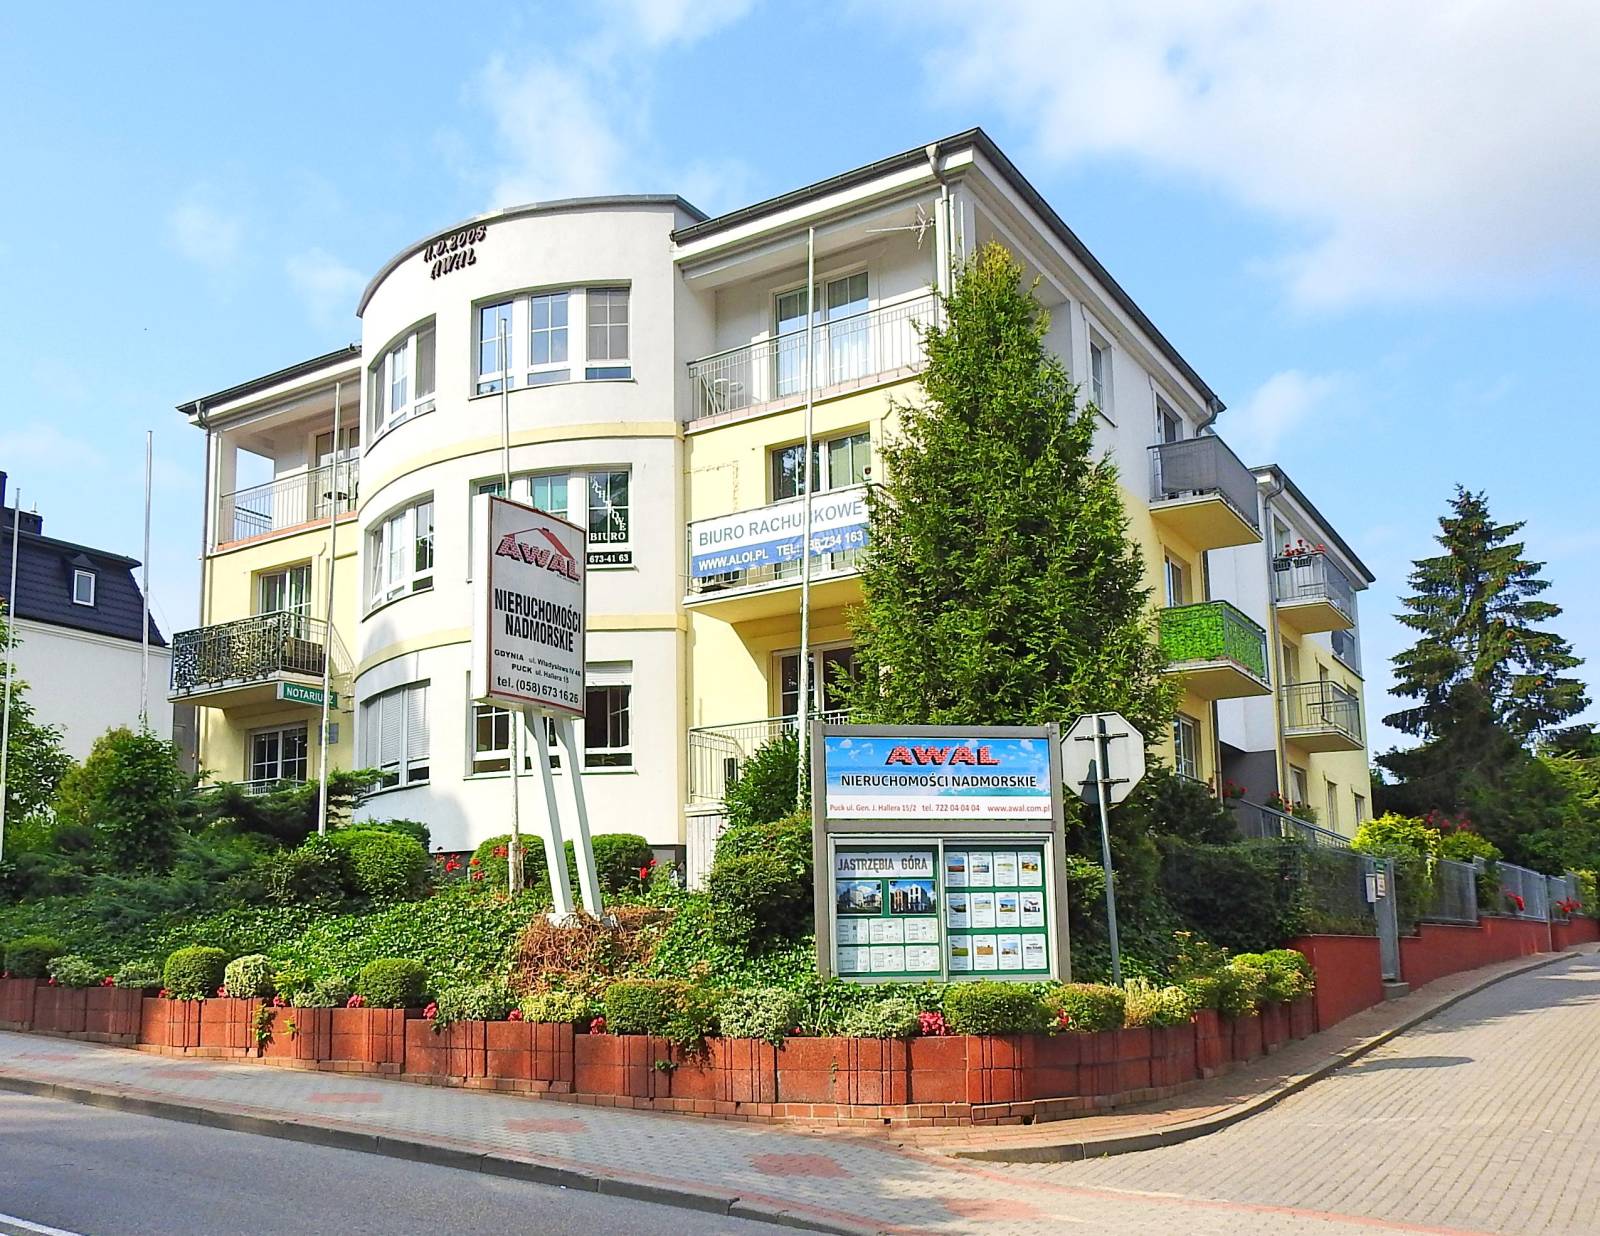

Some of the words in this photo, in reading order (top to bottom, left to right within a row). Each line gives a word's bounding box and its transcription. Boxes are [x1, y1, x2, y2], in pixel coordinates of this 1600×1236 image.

[430, 247, 477, 280] AWAL
[590, 532, 626, 542] BIURO
[700, 524, 745, 546] BIURO
[844, 530, 864, 543] 163
[495, 535, 581, 582] AWAL
[618, 553, 629, 562] 63
[494, 588, 581, 634] NIERUCHOMOŚCI
[505, 613, 574, 652] NADMORSKIE
[494, 648, 524, 661] GDYNIA
[511, 663, 532, 674] PUCK
[286, 687, 333, 704] NOTARIUZ
[497, 675, 514, 689] tel.
[516, 679, 541, 696] (058)
[542, 685, 558, 698] 673
[885, 745, 1002, 766] AWAL
[841, 773, 949, 788] NIERUCHOMOŚCI
[952, 775, 1037, 788] NADMORSKIE
[922, 804, 933, 812] tel.
[936, 804, 948, 812] 722
[987, 804, 1051, 813] www.awal.com.pl
[838, 857, 895, 873] JASTRZĘBIA
[901, 854, 928, 870] GÓRA
